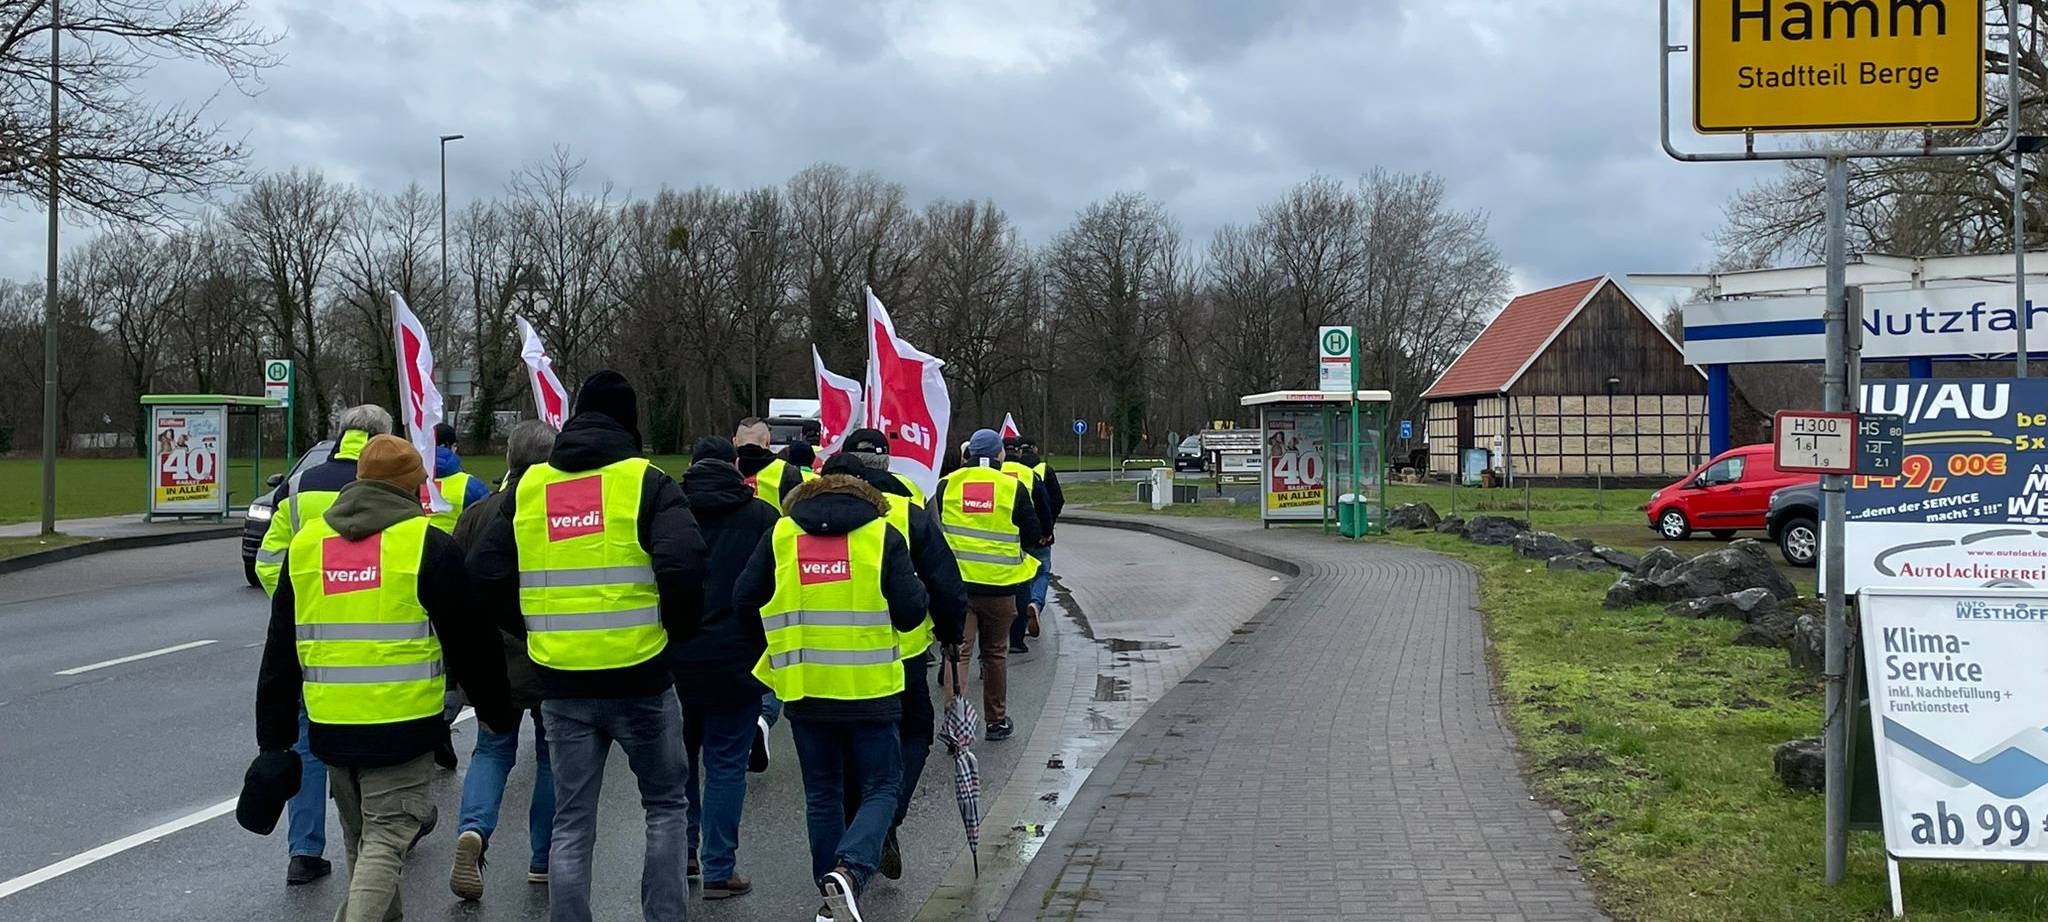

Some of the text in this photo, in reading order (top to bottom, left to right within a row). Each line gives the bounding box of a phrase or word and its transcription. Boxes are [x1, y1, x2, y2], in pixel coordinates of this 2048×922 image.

[1731, 0, 1947, 42] Hamm
[1738, 61, 1939, 90] Stadtteil Berge
[1859, 421, 1902, 436] HS 80
[163, 449, 213, 480] 40
[1274, 451, 1323, 485] 40
[166, 485, 209, 495] IN ALLEN
[1277, 491, 1320, 501] IN ALLEN
[963, 499, 992, 509] ver.di
[1900, 500, 1920, 513] der
[1922, 493, 1980, 509] SERVICE
[550, 510, 600, 529] ver.di
[325, 566, 377, 583] ver.di
[801, 559, 847, 575] ver.di
[1883, 626, 1970, 653] Klima-
[1886, 655, 1983, 682] Service
[1888, 686, 1913, 698] inkl.
[1916, 687, 2001, 702] Nachbefüllung
[1890, 700, 1970, 713] Funktionstest
[1911, 801, 1966, 845] ab
[1976, 804, 2030, 846] 99
